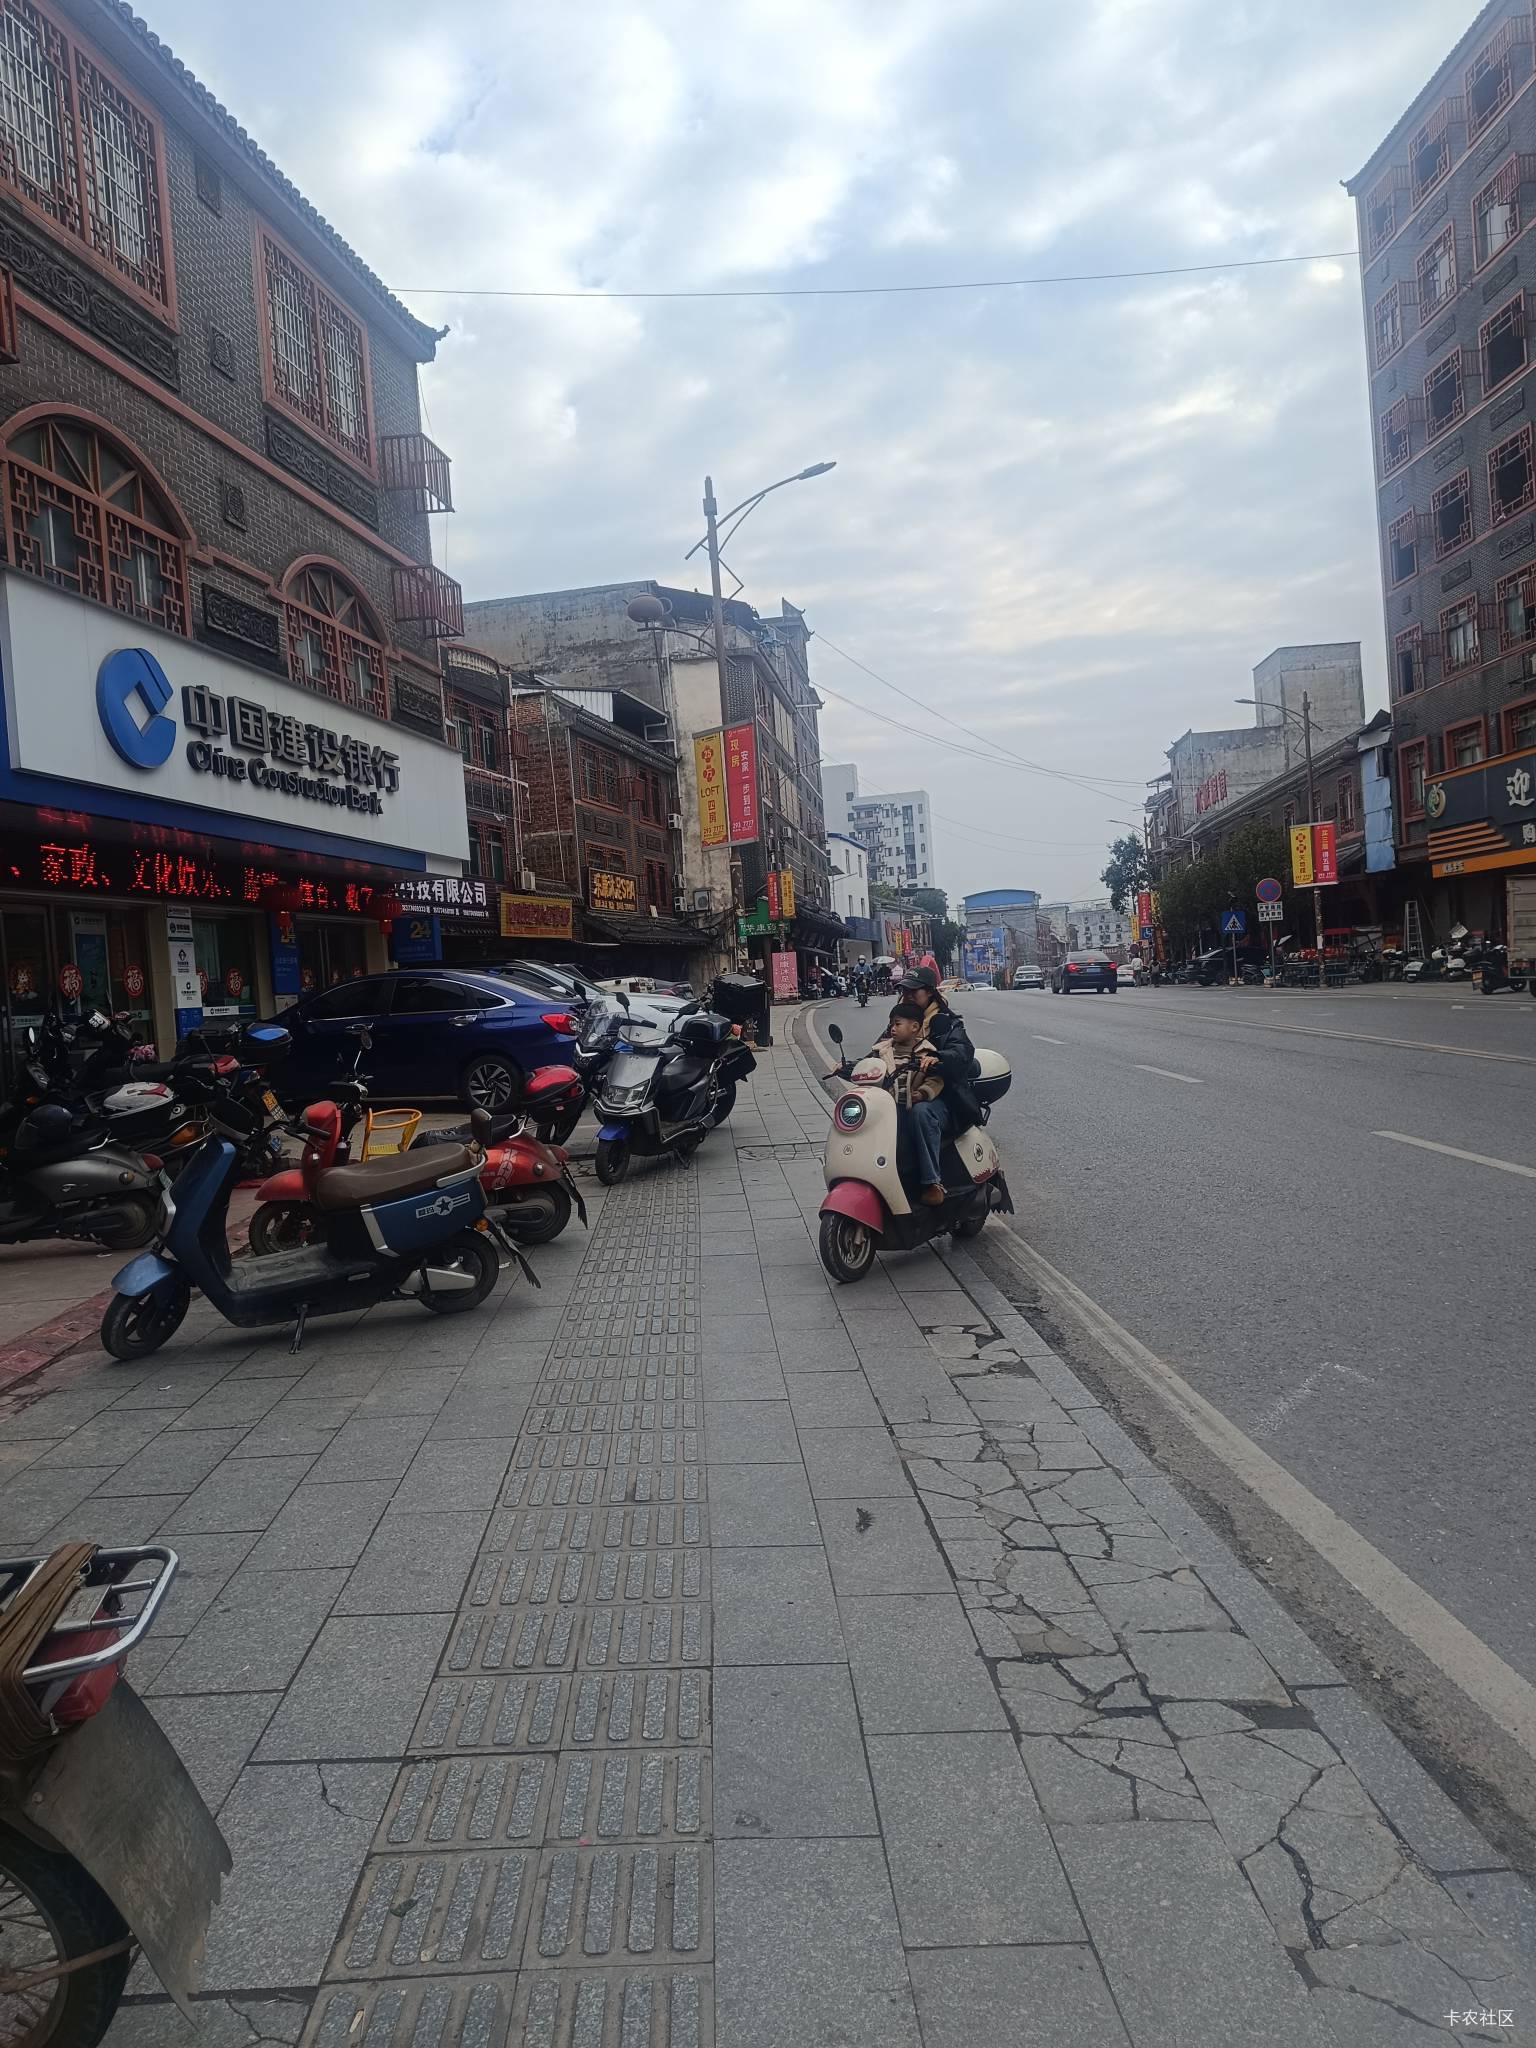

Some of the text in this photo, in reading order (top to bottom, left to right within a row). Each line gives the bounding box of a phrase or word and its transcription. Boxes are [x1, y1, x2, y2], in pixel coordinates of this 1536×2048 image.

[182, 685, 400, 792] 中国建设银行
[187, 740, 384, 816] China Construction Bank
[701, 785, 720, 798] LOFT
[741, 750, 751, 816] 安家一步到位
[1506, 768, 1535, 807] 迎
[127, 969, 144, 991] 福
